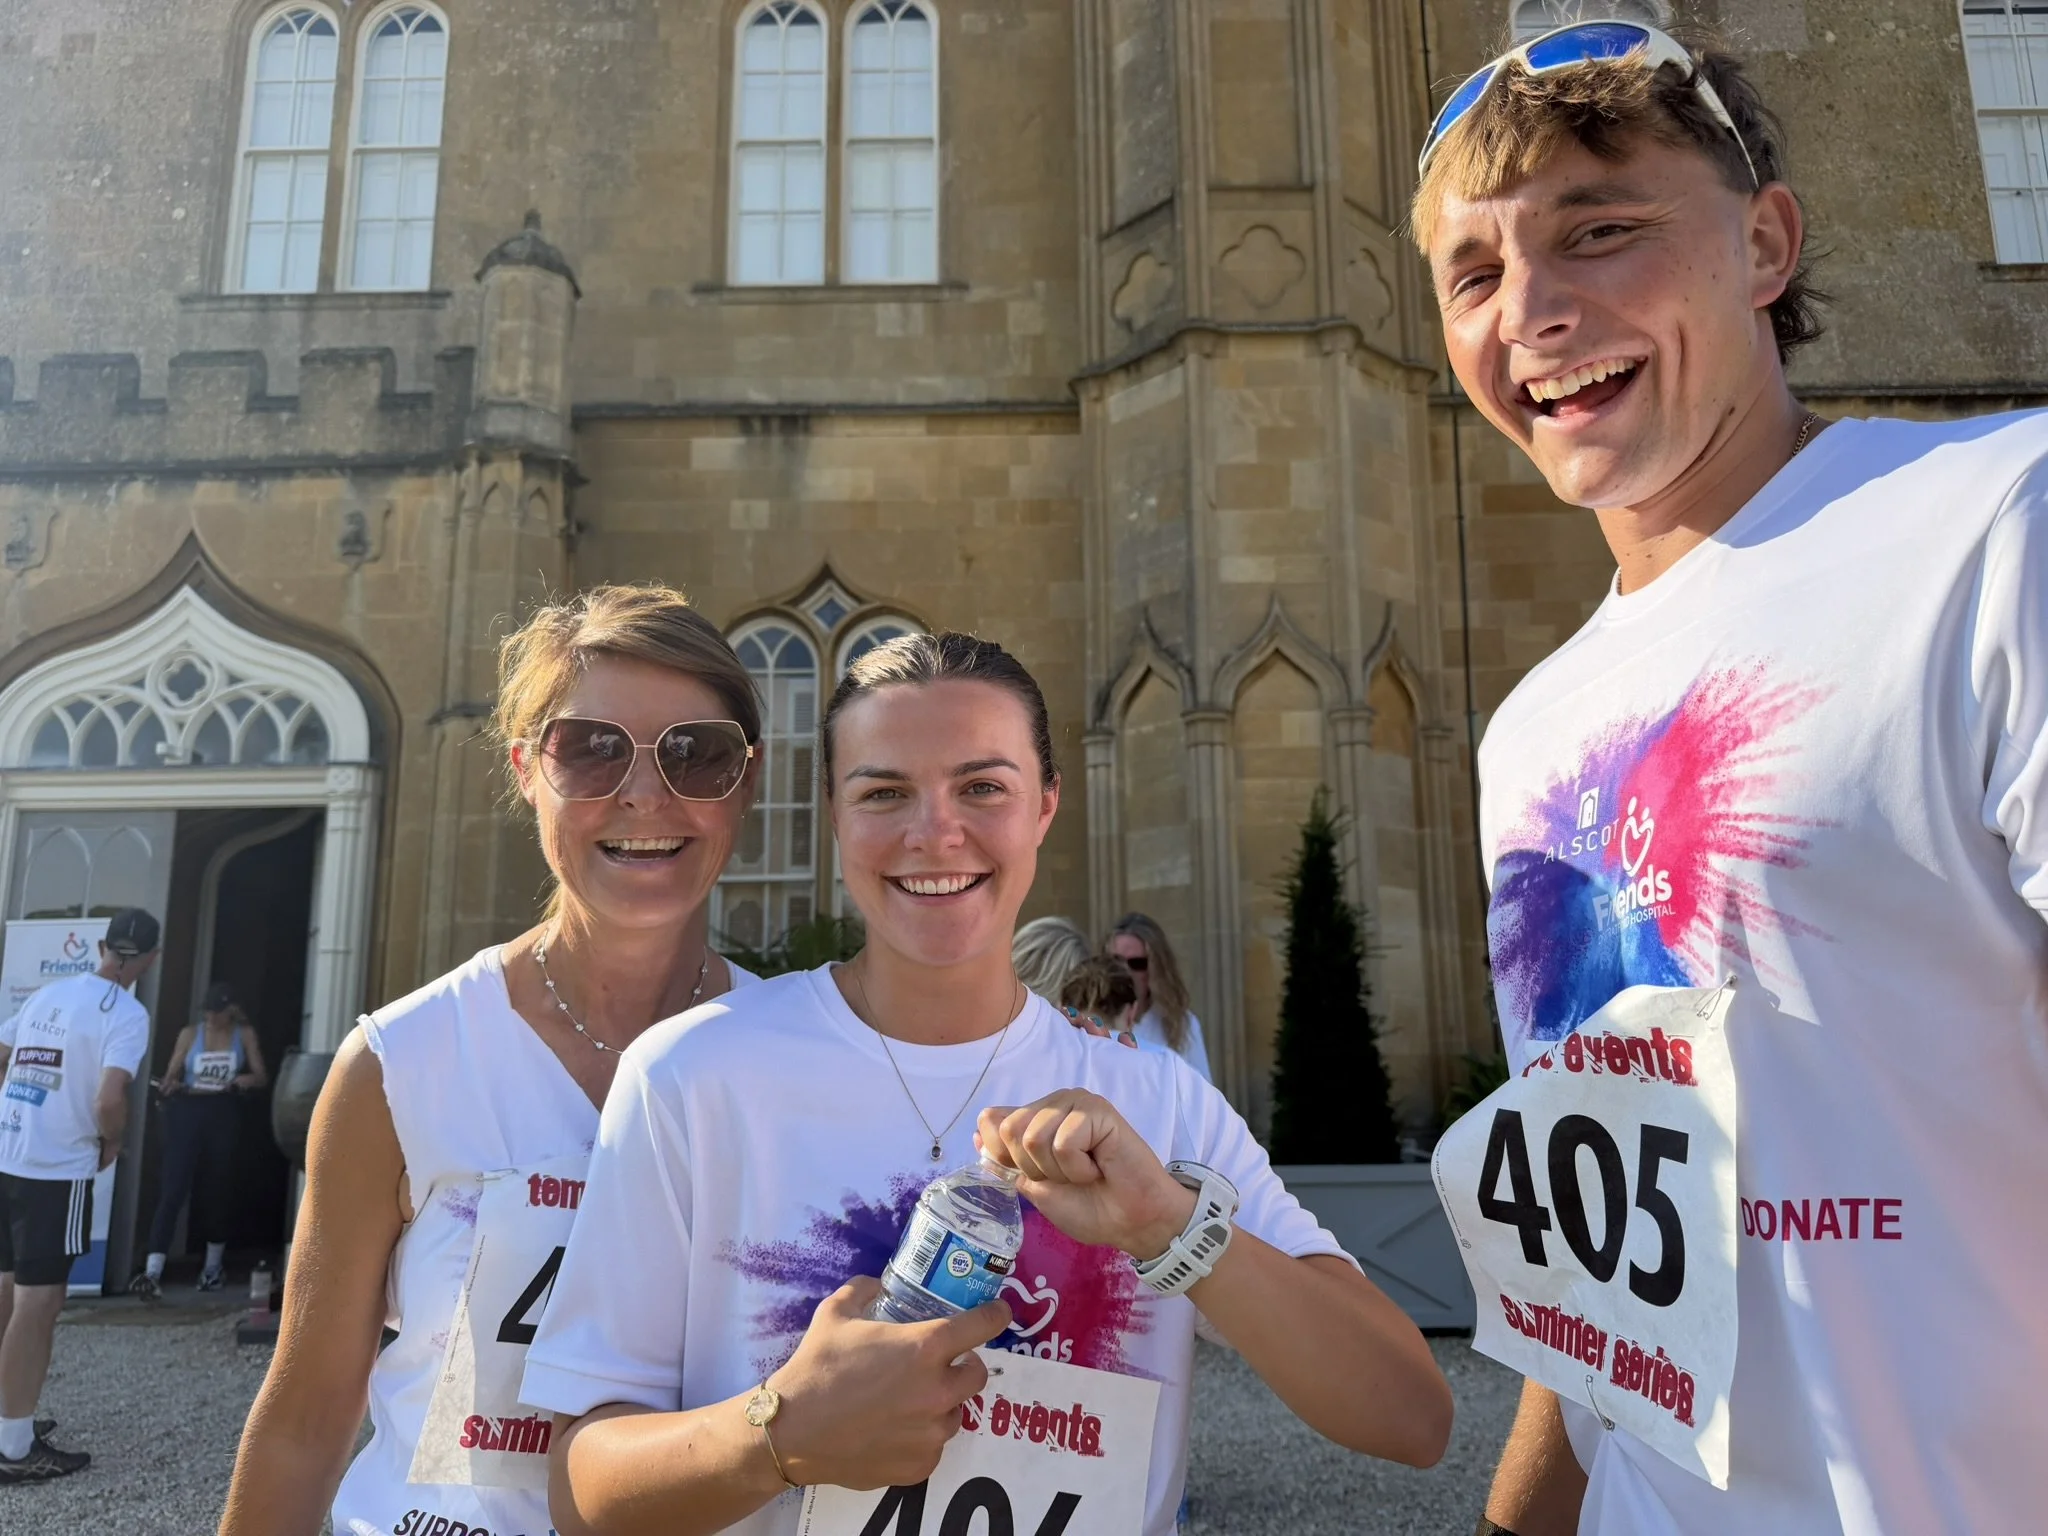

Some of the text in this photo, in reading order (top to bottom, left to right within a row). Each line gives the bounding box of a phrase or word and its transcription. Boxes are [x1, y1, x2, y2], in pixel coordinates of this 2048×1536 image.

[1544, 818, 1619, 864] ALSCOT
[1630, 904, 1676, 926] HOSPITAL
[40, 958, 97, 973] Friends
[18, 1048, 58, 1065] SUPPORT
[1562, 1026, 1698, 1087] events
[1477, 1107, 1690, 1308] 405
[1740, 1197, 1902, 1241] DONATE
[952, 1257, 969, 1268] 50%
[966, 1276, 993, 1296] spring
[999, 1331, 1074, 1363] nds
[1500, 1293, 1696, 1429] summer series
[988, 1393, 1107, 1458] events
